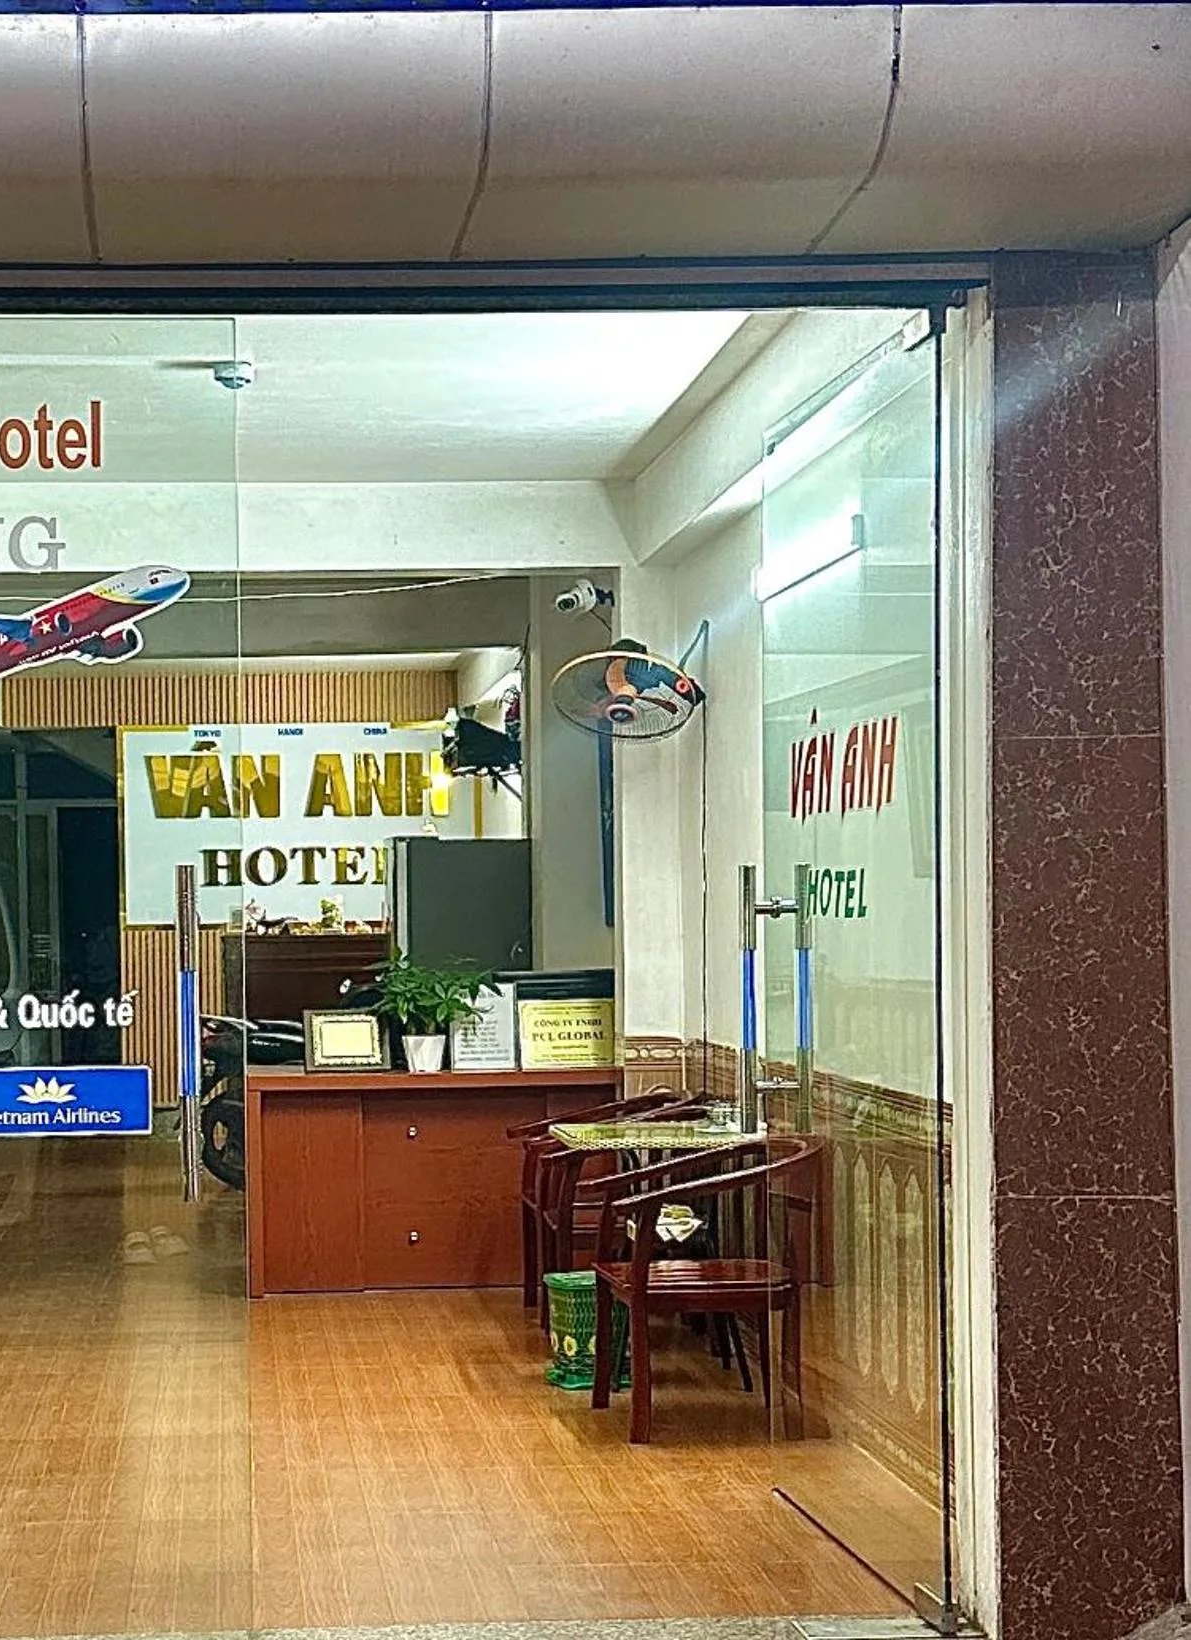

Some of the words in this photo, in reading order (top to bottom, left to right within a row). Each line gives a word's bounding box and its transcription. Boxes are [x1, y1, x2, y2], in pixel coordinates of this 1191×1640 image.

[143, 740, 281, 819] VÂN
[303, 750, 451, 818] ANH
[841, 714, 899, 825] ANH
[806, 867, 868, 920] HOTEL
[17, 988, 96, 1029] Quốc
[103, 989, 140, 1028] tế
[52, 1106, 122, 1125] Airlines
